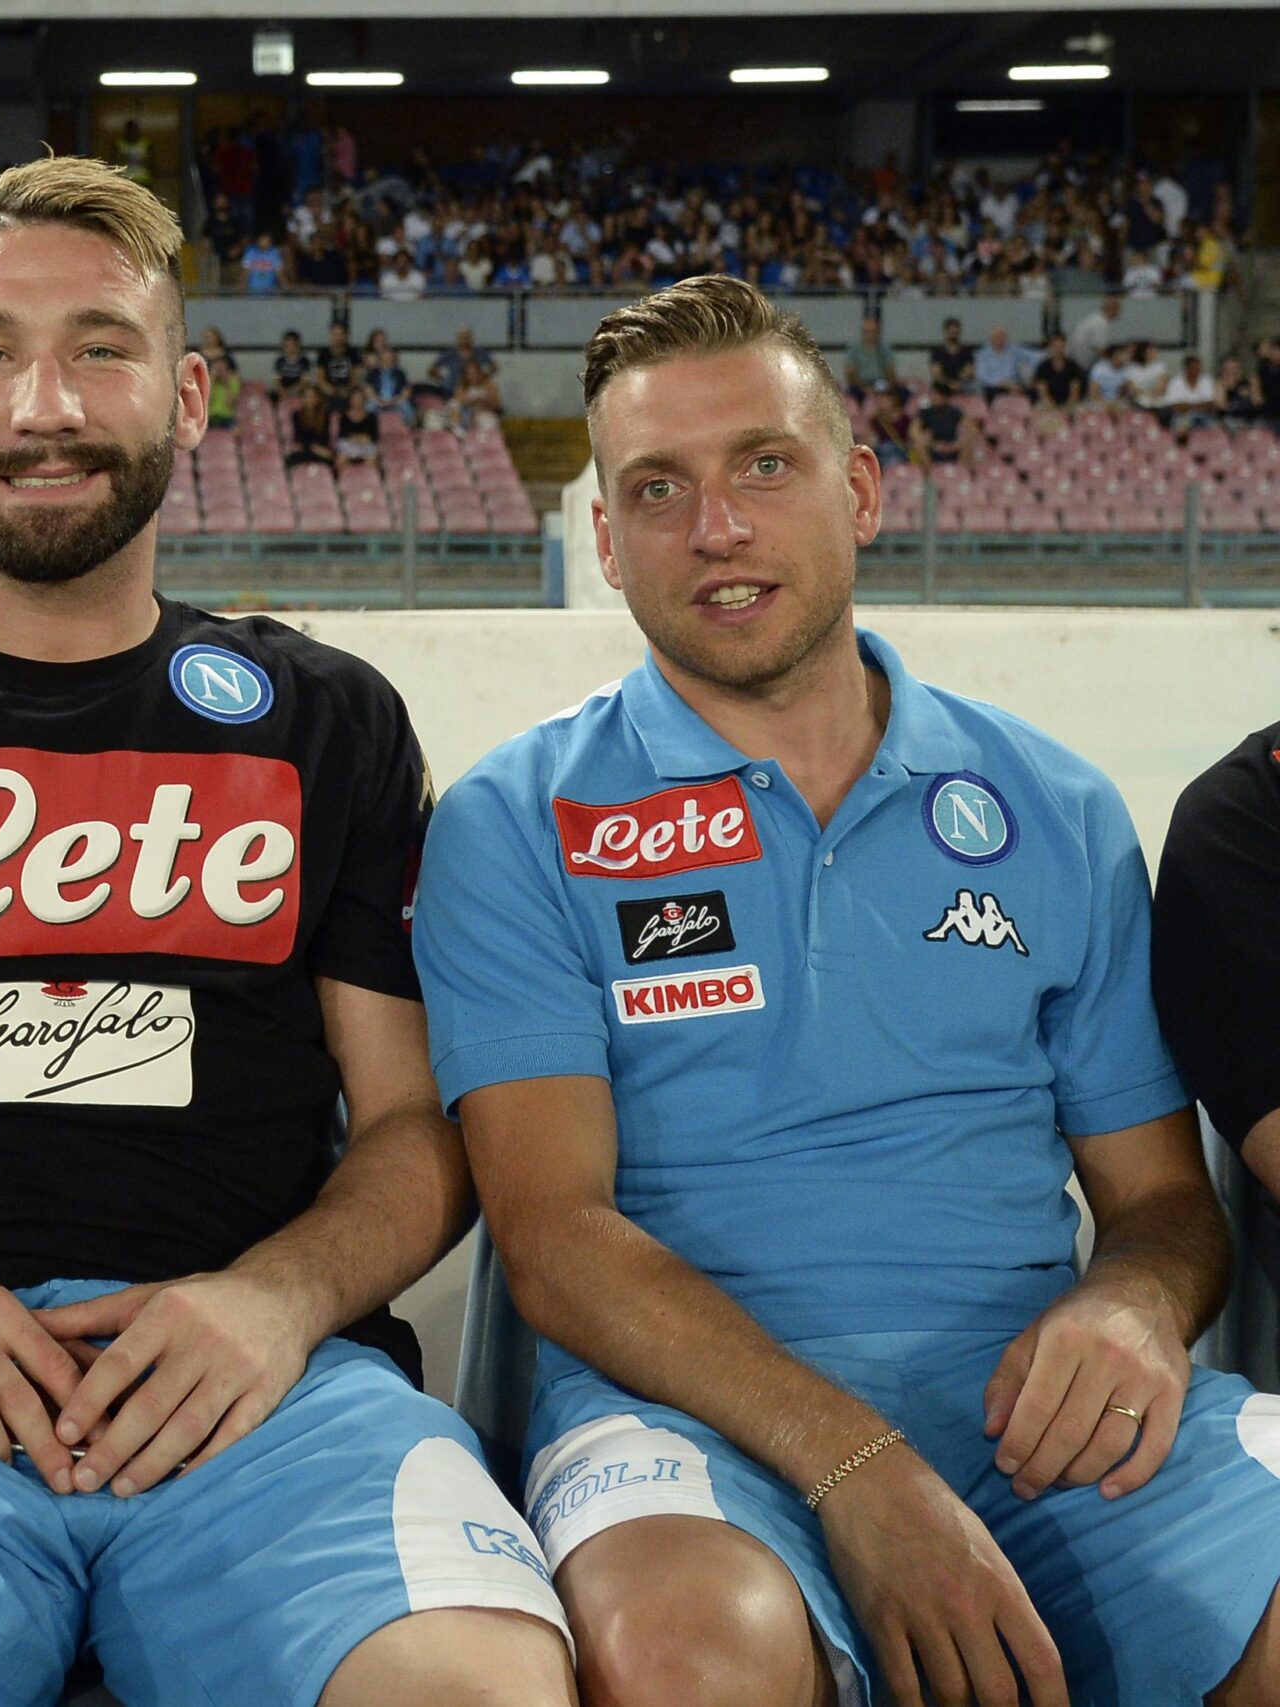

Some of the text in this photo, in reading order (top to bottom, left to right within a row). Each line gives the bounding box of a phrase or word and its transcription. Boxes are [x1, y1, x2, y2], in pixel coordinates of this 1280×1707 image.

[193, 662, 244, 703] N
[571, 798, 746, 871] Lete
[947, 792, 990, 843] N
[632, 905, 721, 959] Garofalo
[623, 975, 754, 1017] KIMBO
[536, 1457, 682, 1548] POLI
